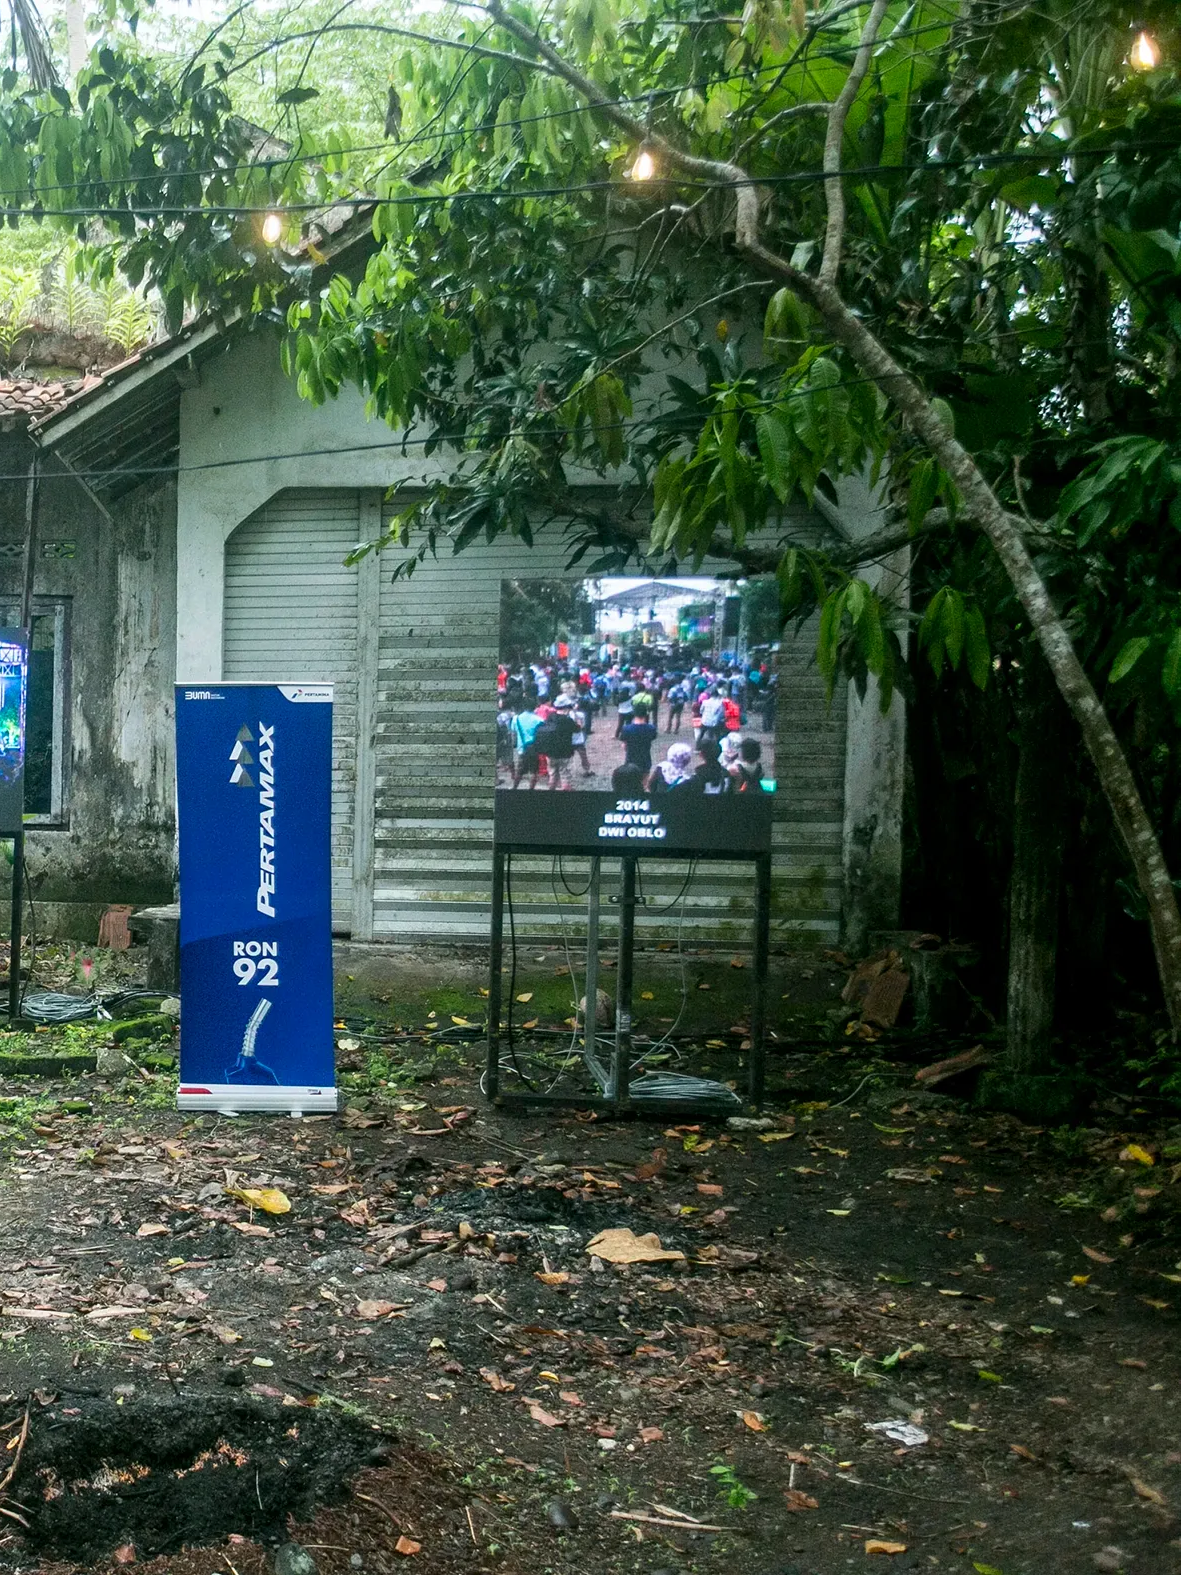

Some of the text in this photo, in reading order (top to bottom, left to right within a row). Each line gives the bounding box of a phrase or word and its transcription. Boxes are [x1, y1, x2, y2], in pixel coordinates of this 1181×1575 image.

[616, 800, 649, 811] 2014
[257, 721, 276, 918] PERTAMAX
[604, 813, 660, 825] BRAYUT
[598, 826, 666, 838] DWI OBLO
[233, 941, 278, 957] RON
[232, 957, 279, 986] 92
